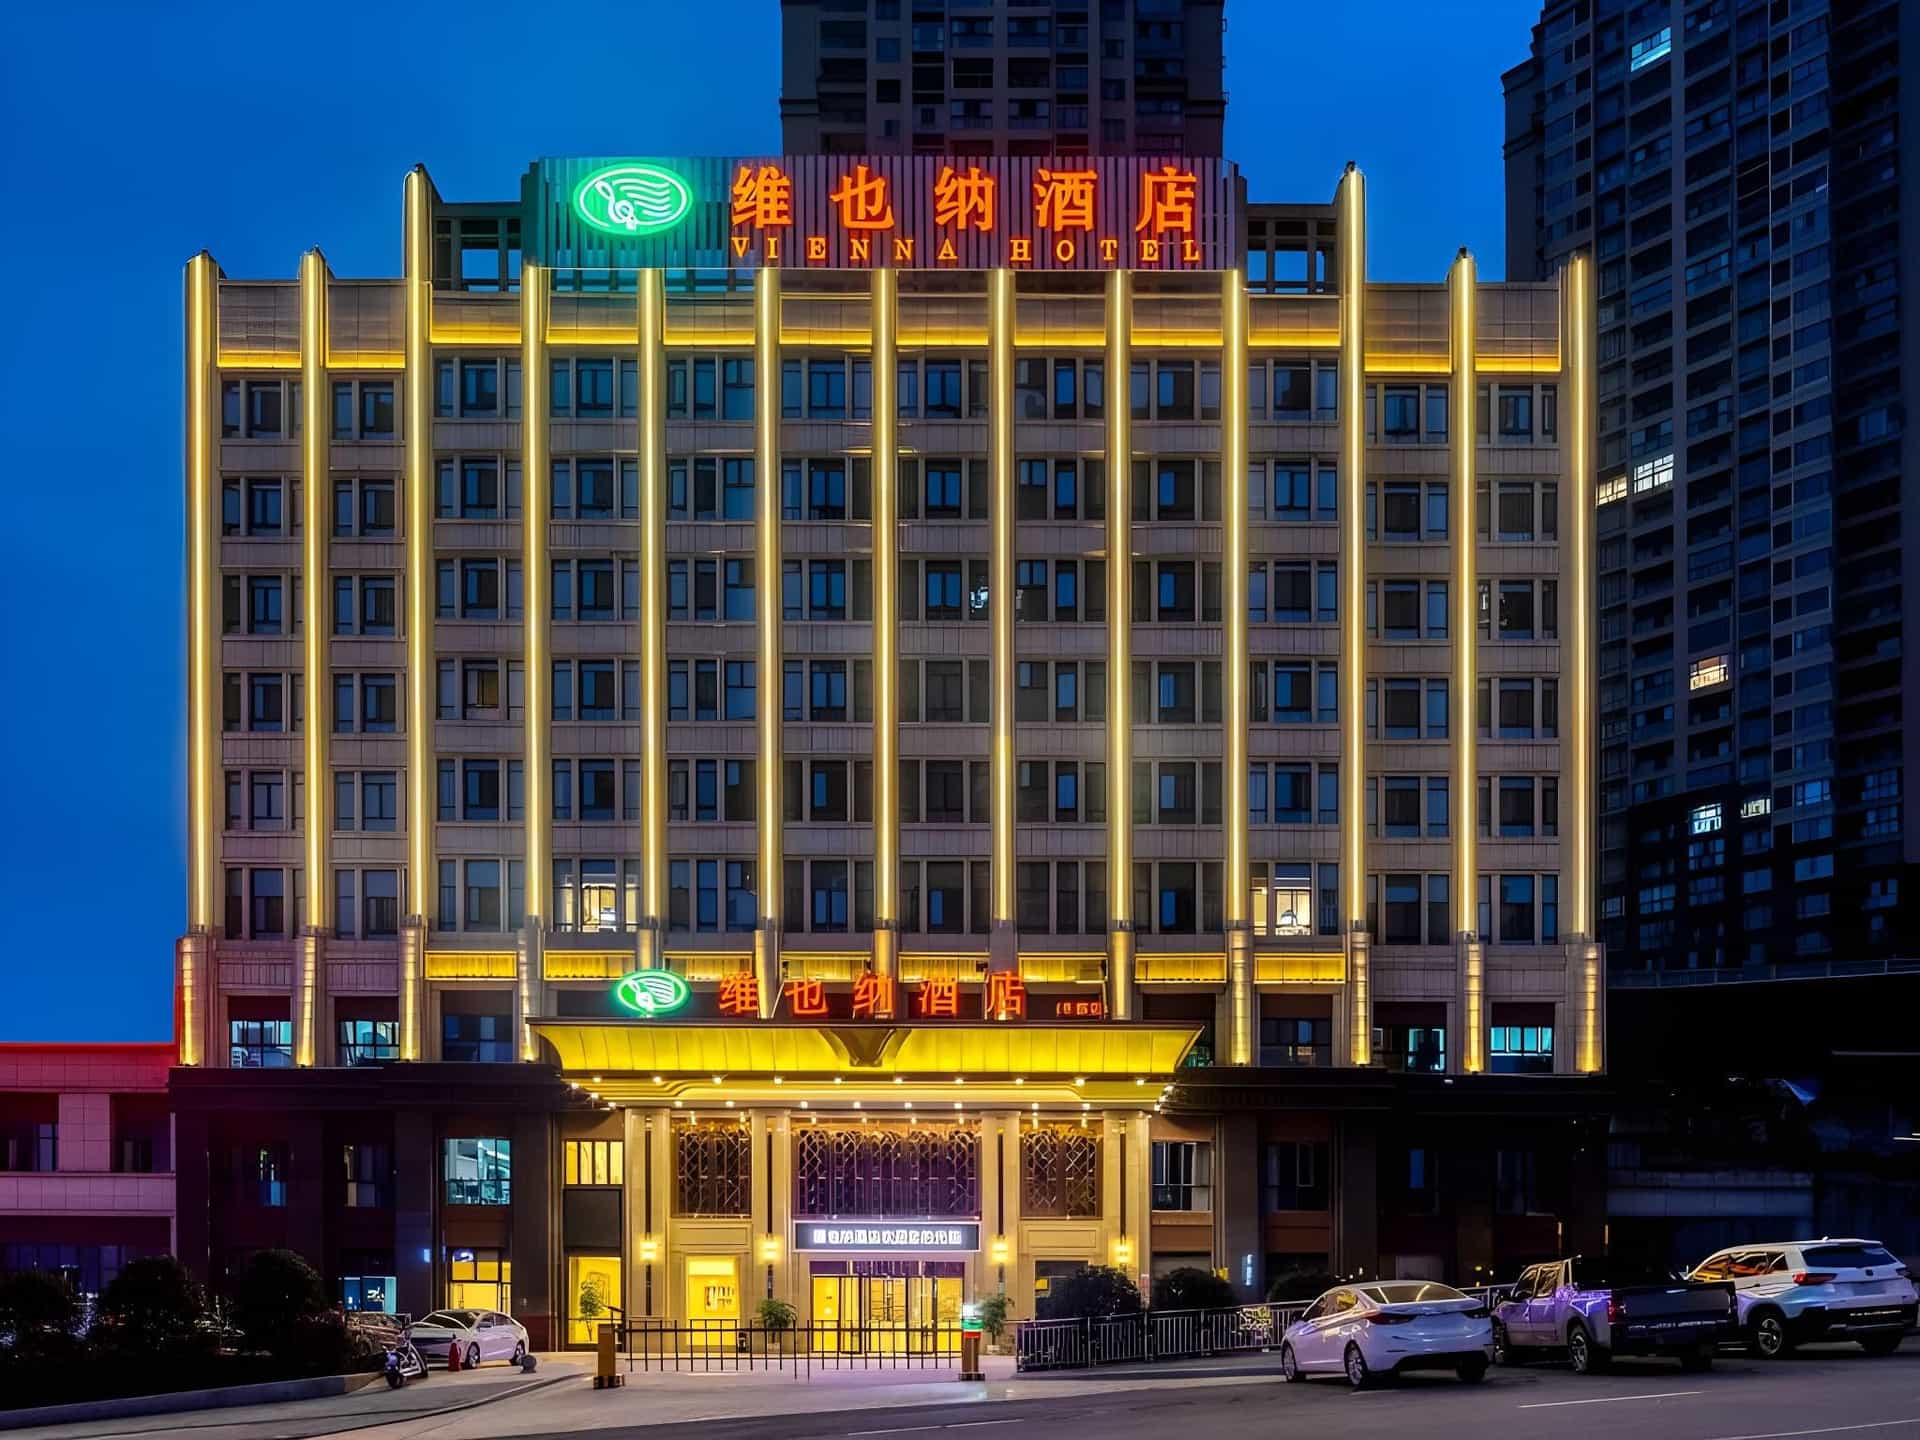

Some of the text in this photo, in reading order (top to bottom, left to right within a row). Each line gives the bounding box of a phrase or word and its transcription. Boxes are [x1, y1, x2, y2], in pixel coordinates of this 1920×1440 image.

[731, 165, 1197, 233] 维也纳酒店
[731, 236, 1201, 262] VIENNA HOTEL
[719, 970, 1025, 1016] 维也纳酒店
